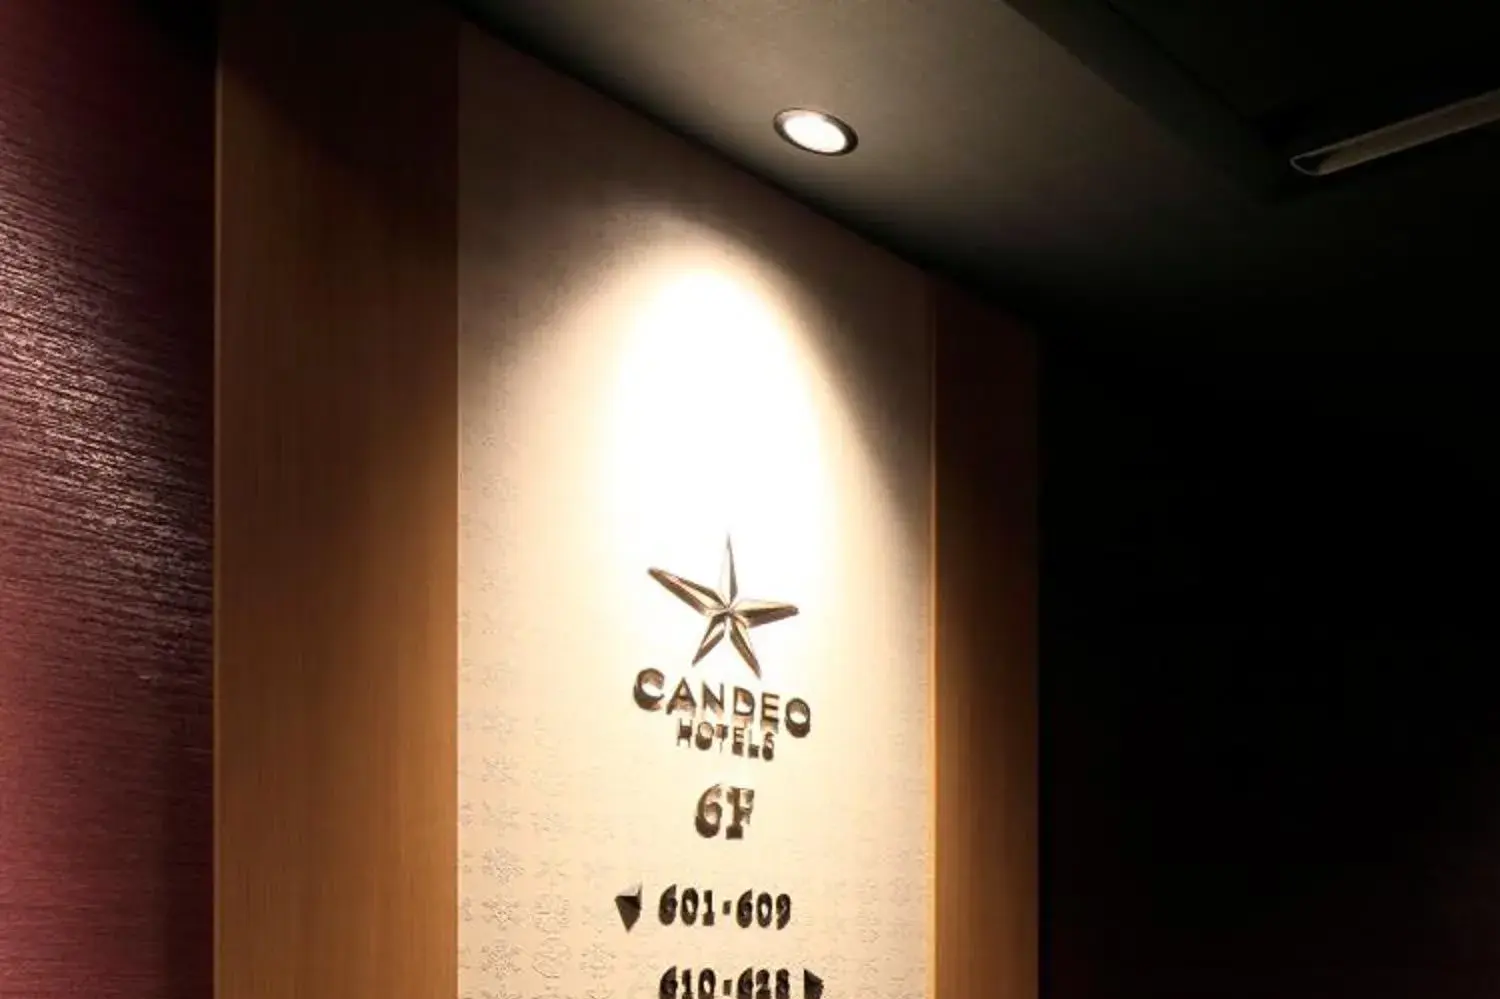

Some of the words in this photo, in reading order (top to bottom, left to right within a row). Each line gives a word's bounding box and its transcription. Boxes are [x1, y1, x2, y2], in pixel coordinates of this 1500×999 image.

[633, 667, 811, 738] CANDEO
[676, 717, 775, 761] HOTELS
[695, 783, 755, 840] 6F
